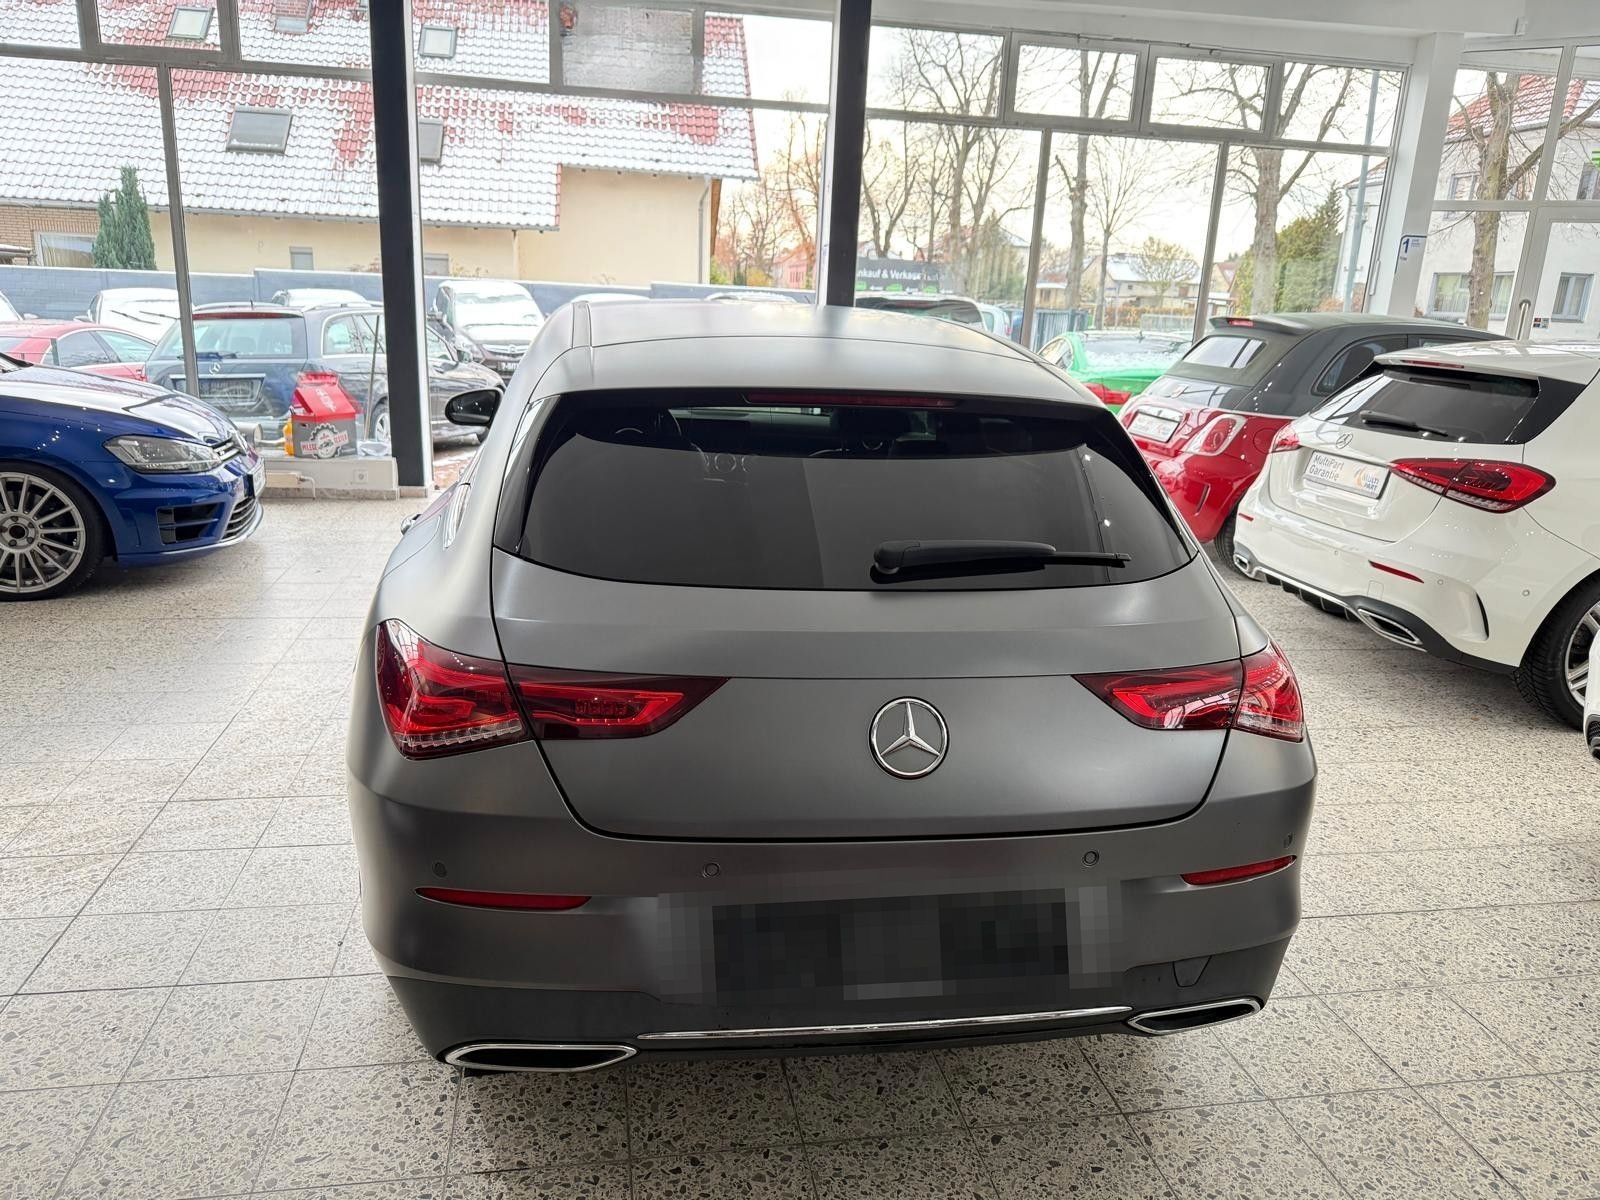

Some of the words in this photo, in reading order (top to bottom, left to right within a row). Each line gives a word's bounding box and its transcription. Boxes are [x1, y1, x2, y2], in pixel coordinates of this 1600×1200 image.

[1403, 238, 1410, 253] 1
[857, 268, 881, 278] nkauf
[881, 268, 889, 279] &
[1313, 454, 1345, 470] MultiPart
[1309, 464, 1340, 481] Garantie
